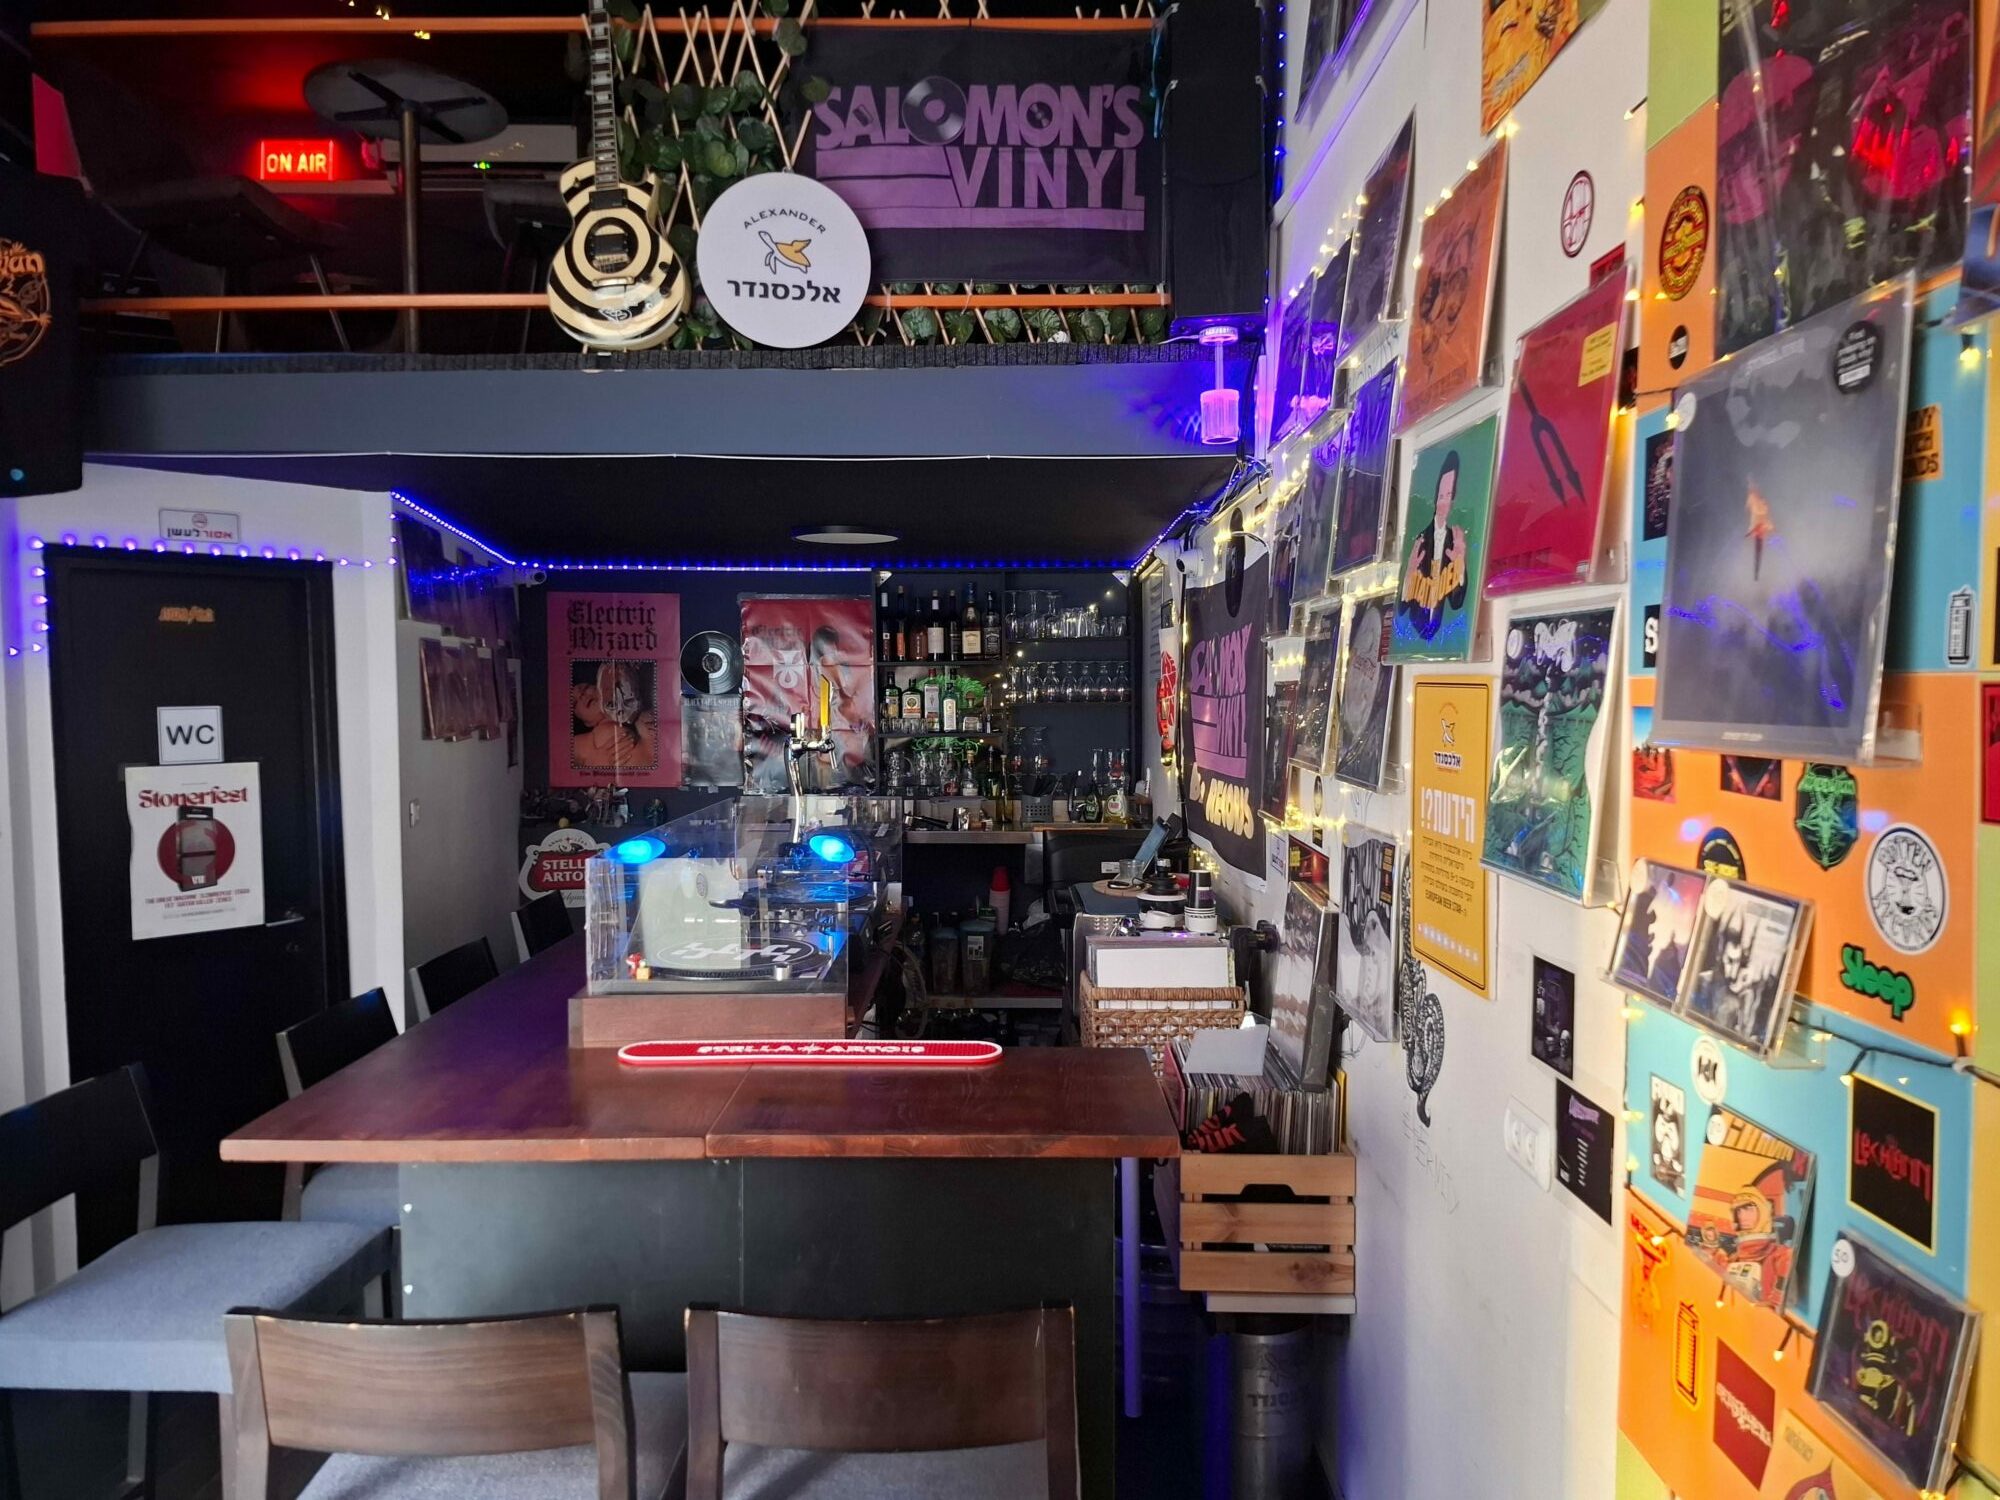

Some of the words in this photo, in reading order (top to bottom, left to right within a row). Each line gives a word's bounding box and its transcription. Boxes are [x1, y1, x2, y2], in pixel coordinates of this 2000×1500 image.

[814, 75, 1145, 150] SALOMON'S
[266, 152, 292, 174] ON
[297, 152, 328, 174] AIR
[943, 146, 1146, 210] VINYL
[743, 208, 827, 235] ALEXANDER
[727, 279, 842, 303] אלכסנדר
[567, 600, 656, 625] Electric
[566, 625, 658, 657] Wizard
[166, 724, 214, 746] WC
[138, 786, 249, 809] Stonerfest
[541, 870, 585, 883] ARTO
[542, 859, 586, 870] STELL
[1841, 944, 1914, 1022] Sleep
[697, 1045, 795, 1054] STELLA
[827, 1045, 926, 1054] ARTOIS
